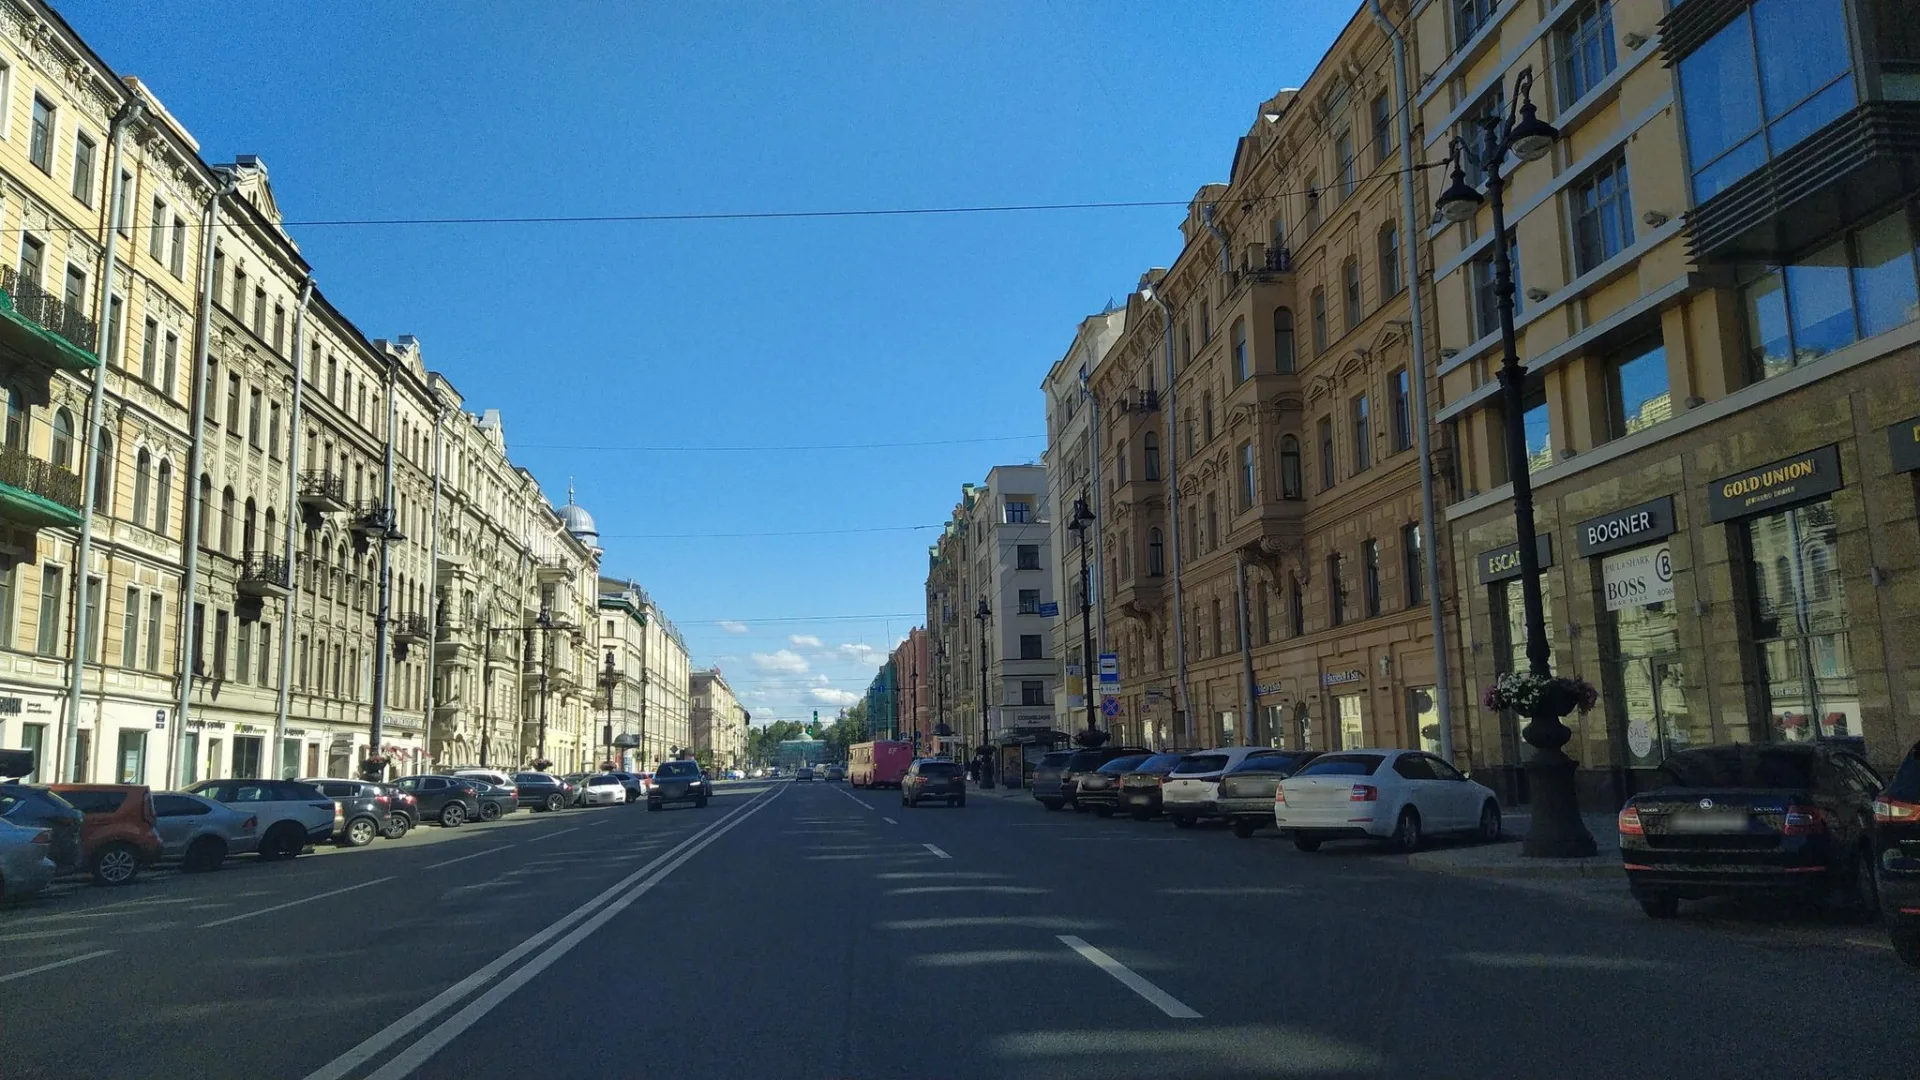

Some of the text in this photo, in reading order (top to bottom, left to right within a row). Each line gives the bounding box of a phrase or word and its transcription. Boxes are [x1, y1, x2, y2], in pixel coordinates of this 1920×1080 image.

[1723, 475, 1760, 498] GOLD
[1762, 459, 1813, 487] UNION
[1588, 512, 1650, 546] BOGNER
[1608, 576, 1646, 600] BOSS
[1629, 727, 1649, 738] SALE
